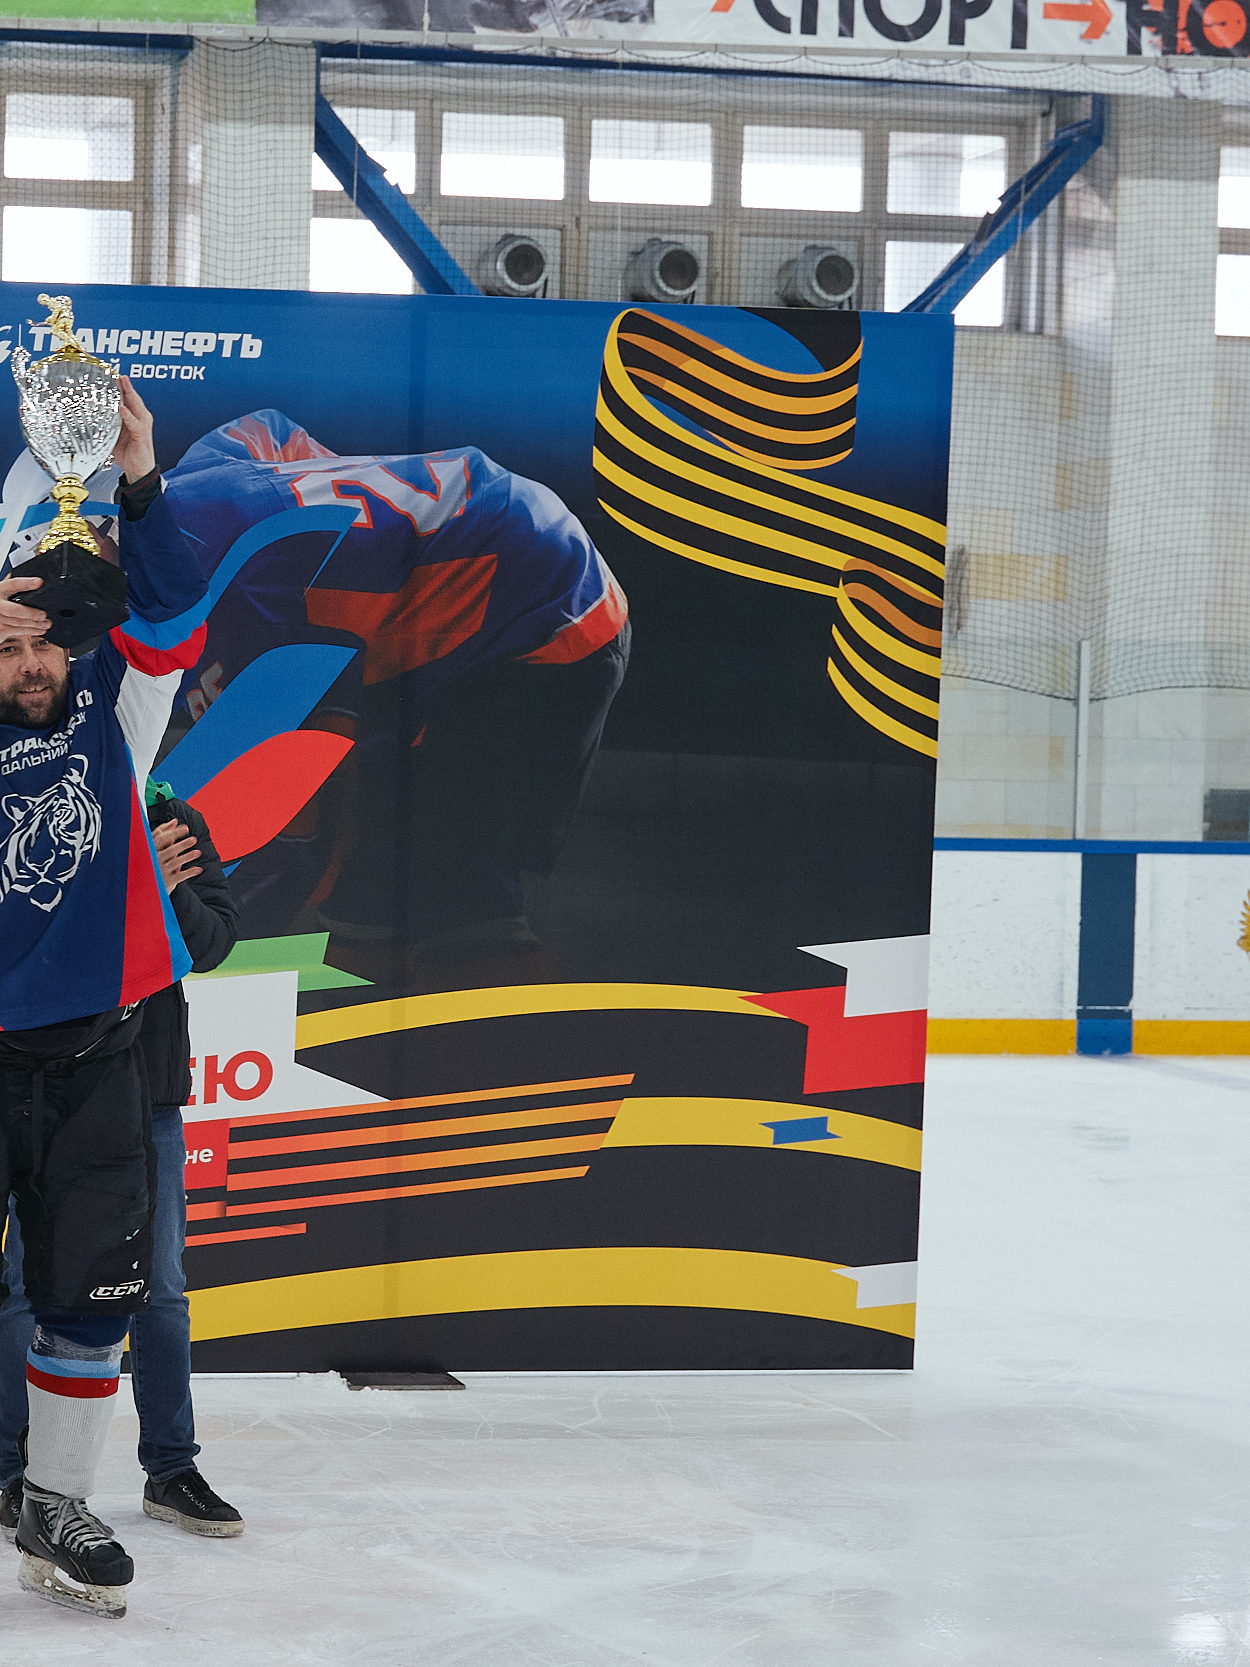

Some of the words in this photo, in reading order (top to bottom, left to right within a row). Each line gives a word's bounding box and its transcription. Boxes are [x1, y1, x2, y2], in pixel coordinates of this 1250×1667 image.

[130, 363, 206, 381] ВОСТОК
[186, 1050, 274, 1107] Ю
[185, 1148, 214, 1165] не
[94, 1282, 141, 1298] CCM
